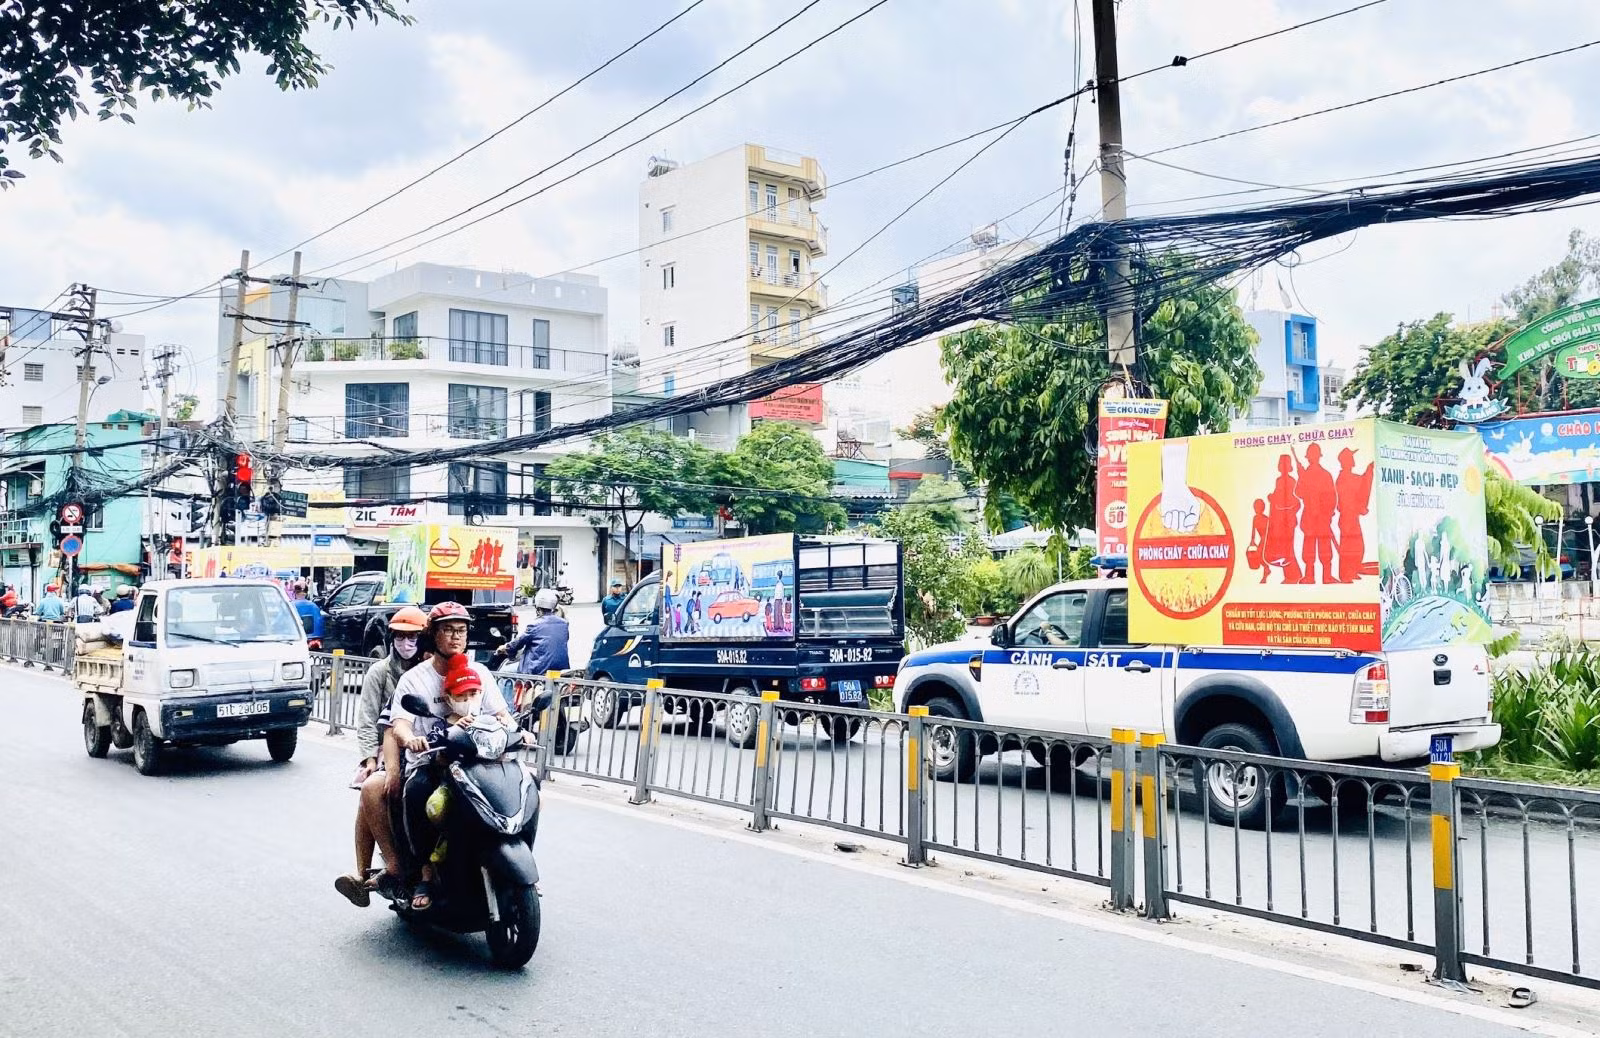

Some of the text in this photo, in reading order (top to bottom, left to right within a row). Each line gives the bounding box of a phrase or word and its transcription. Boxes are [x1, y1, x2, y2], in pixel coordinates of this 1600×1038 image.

[1381, 467, 1459, 491] XANH SẠCH ĐẸP
[355, 510, 377, 521] ZIC
[390, 504, 417, 517] TÂM
[1010, 649, 1122, 668] CẢNH SÁT
[843, 681, 856, 690] 50A
[1435, 739, 1448, 752] 50A
